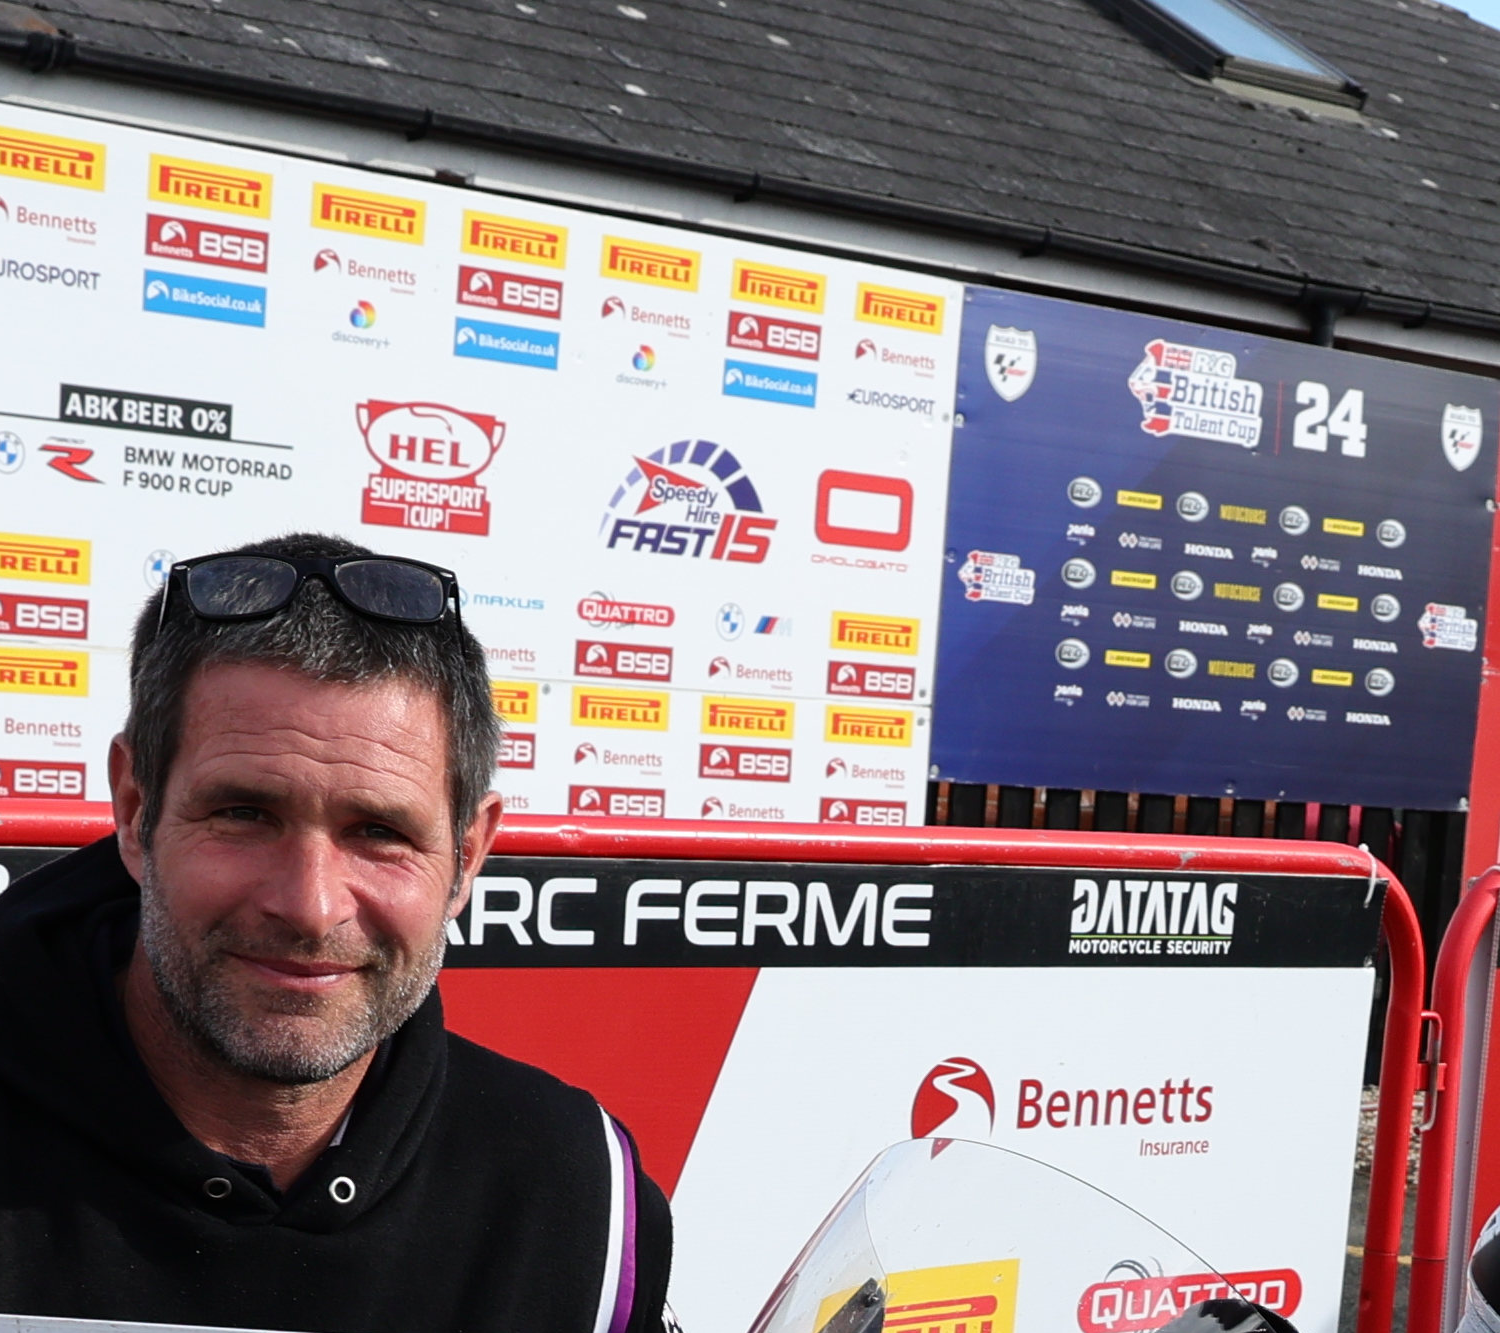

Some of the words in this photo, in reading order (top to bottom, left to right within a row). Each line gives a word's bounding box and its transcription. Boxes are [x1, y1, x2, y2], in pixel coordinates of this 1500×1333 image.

[631, 305, 690, 330] Bennetts
[766, 326, 818, 354] BSB
[65, 393, 116, 422] ABK
[122, 399, 183, 428] BEER
[191, 405, 227, 434] 0%
[1173, 374, 1257, 415] British
[1293, 381, 1367, 457] 24
[1174, 412, 1223, 434] Talent
[1227, 420, 1257, 444] Cup
[124, 446, 175, 470] BMW
[182, 453, 291, 481] MOTORRAD
[389, 434, 471, 467] HEL
[123, 470, 134, 487] F
[138, 471, 175, 491] 900
[179, 475, 192, 492] R
[196, 477, 232, 497] CUP
[371, 476, 483, 509] SUPERSPORT
[650, 476, 717, 508] Speedy
[409, 506, 447, 530] CUP
[686, 503, 720, 526] Hire
[1185, 544, 1233, 559] HONDA
[1358, 564, 1402, 580] HONDA
[473, 592, 544, 610] MAXUS
[838, 619, 911, 649] PIRELLI
[624, 879, 934, 947] FERME
[1070, 878, 1238, 937] DATATAG
[1068, 938, 1168, 955] MOTORCYCLE
[1172, 938, 1231, 955] SECURITY
[1015, 1076, 1213, 1130] Bennetts
[1138, 1137, 1210, 1157] Insurance
